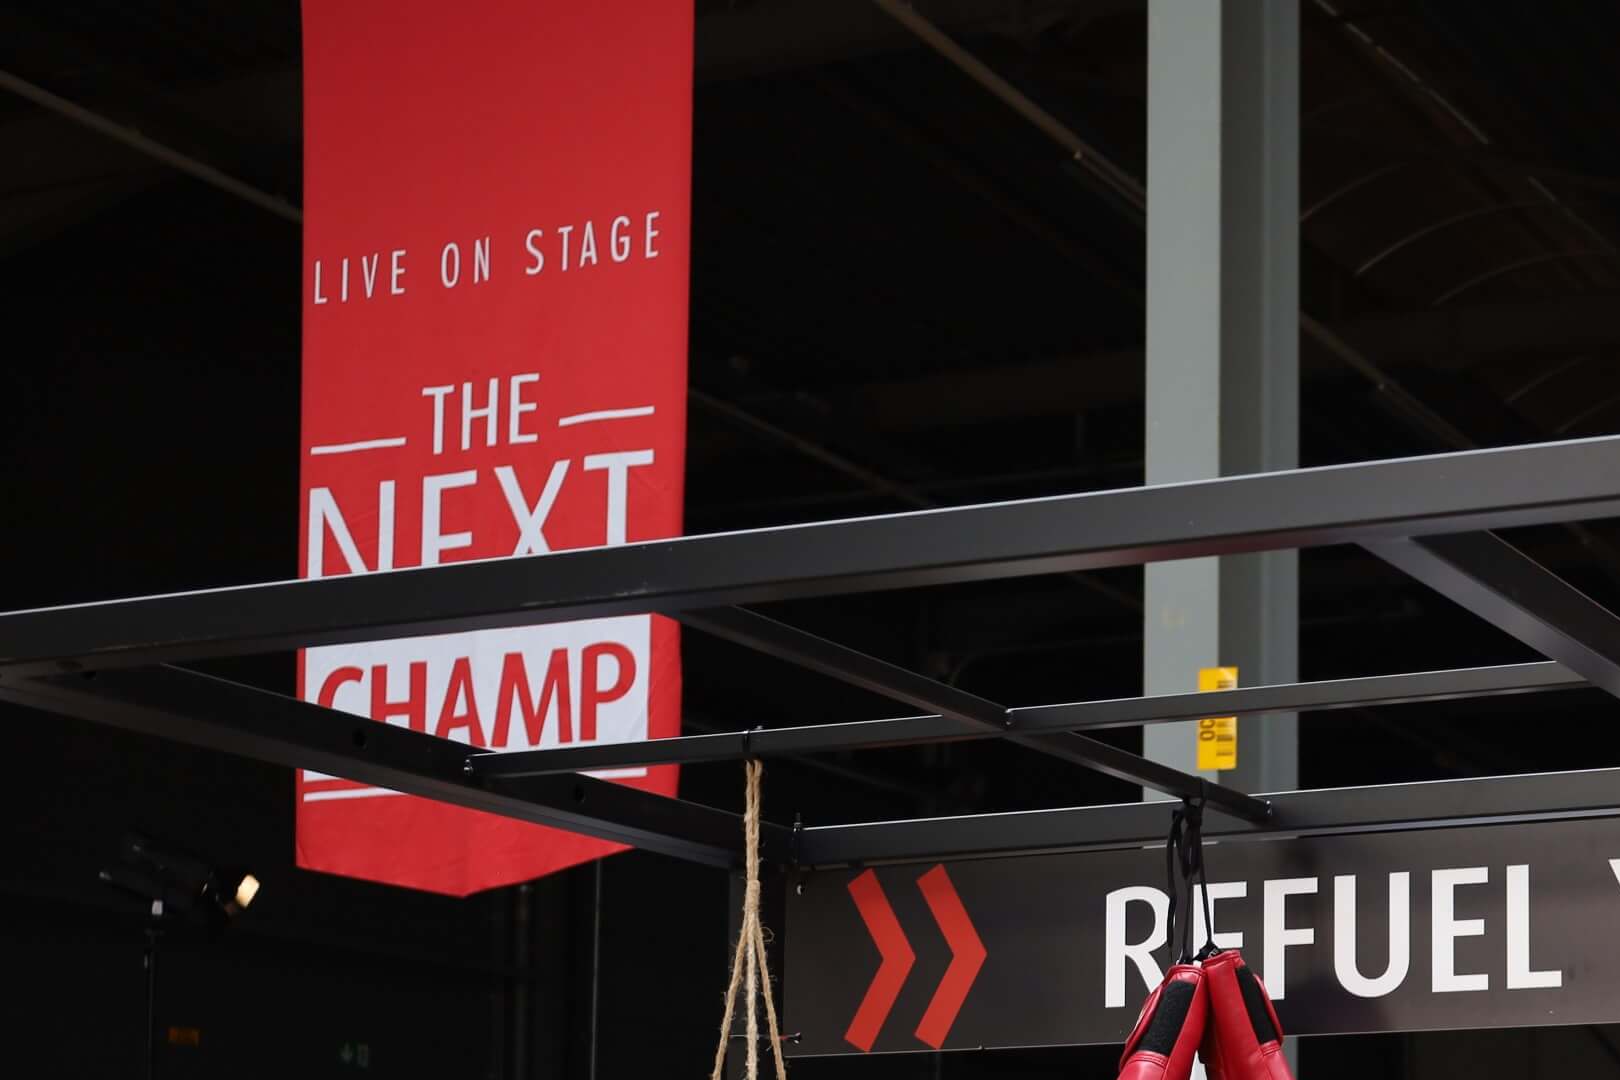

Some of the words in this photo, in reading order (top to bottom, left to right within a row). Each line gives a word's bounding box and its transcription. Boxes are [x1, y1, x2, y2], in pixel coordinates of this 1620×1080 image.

[313, 249, 407, 305] LIVE
[440, 236, 491, 289] ON
[525, 211, 661, 276] STAGE
[421, 372, 541, 456] THE
[307, 449, 654, 581] NEXT
[1105, 863, 1563, 1009] REFUEL
